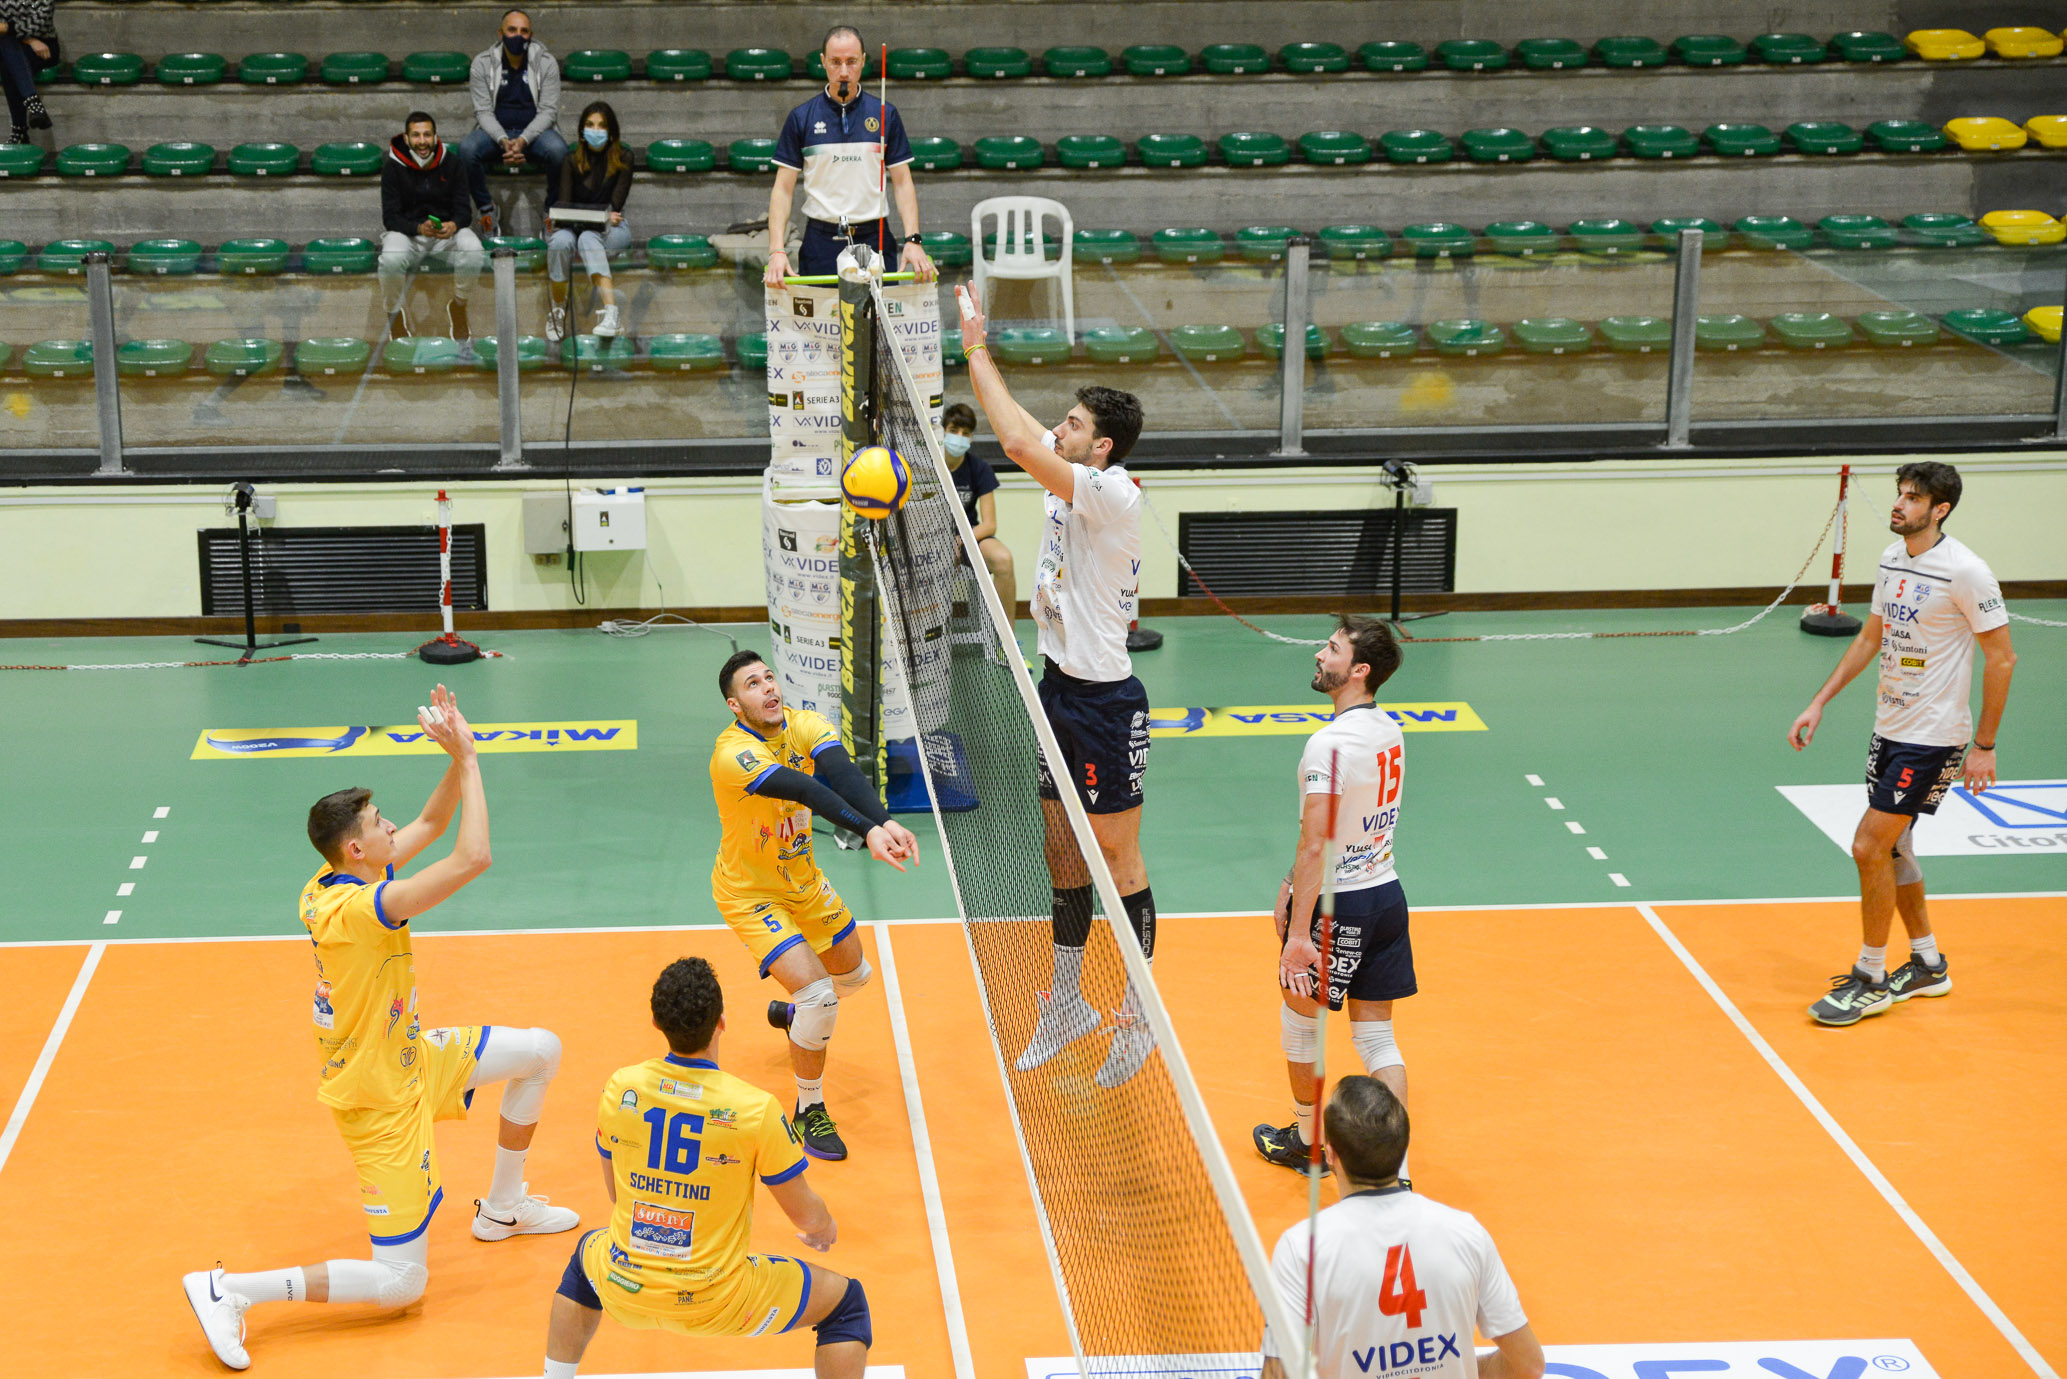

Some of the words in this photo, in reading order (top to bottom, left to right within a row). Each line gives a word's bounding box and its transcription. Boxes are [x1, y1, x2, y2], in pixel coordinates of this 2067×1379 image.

[813, 322, 840, 335] VID
[904, 320, 938, 335] VIDE
[807, 396, 828, 404] SERIE
[829, 395, 840, 403] A3
[814, 416, 841, 428] VID
[797, 557, 840, 573] VIDE
[1896, 578, 1907, 599] 5
[1882, 602, 1920, 625] VIDEX
[1978, 598, 1999, 612] RIEN
[796, 636, 814, 646] SERIE
[815, 638, 825, 648] A3
[841, 580, 855, 694] BANCA
[1891, 628, 1912, 640] UASA
[1084, 763, 1098, 786] 3
[1376, 744, 1402, 808] 15
[1896, 767, 1915, 788] 5
[761, 913, 783, 933] 5
[643, 1106, 705, 1176] 16
[629, 1172, 711, 1201] SCHETTINO
[1378, 1241, 1428, 1329] 4
[1352, 1331, 1461, 1373] VIDEX
